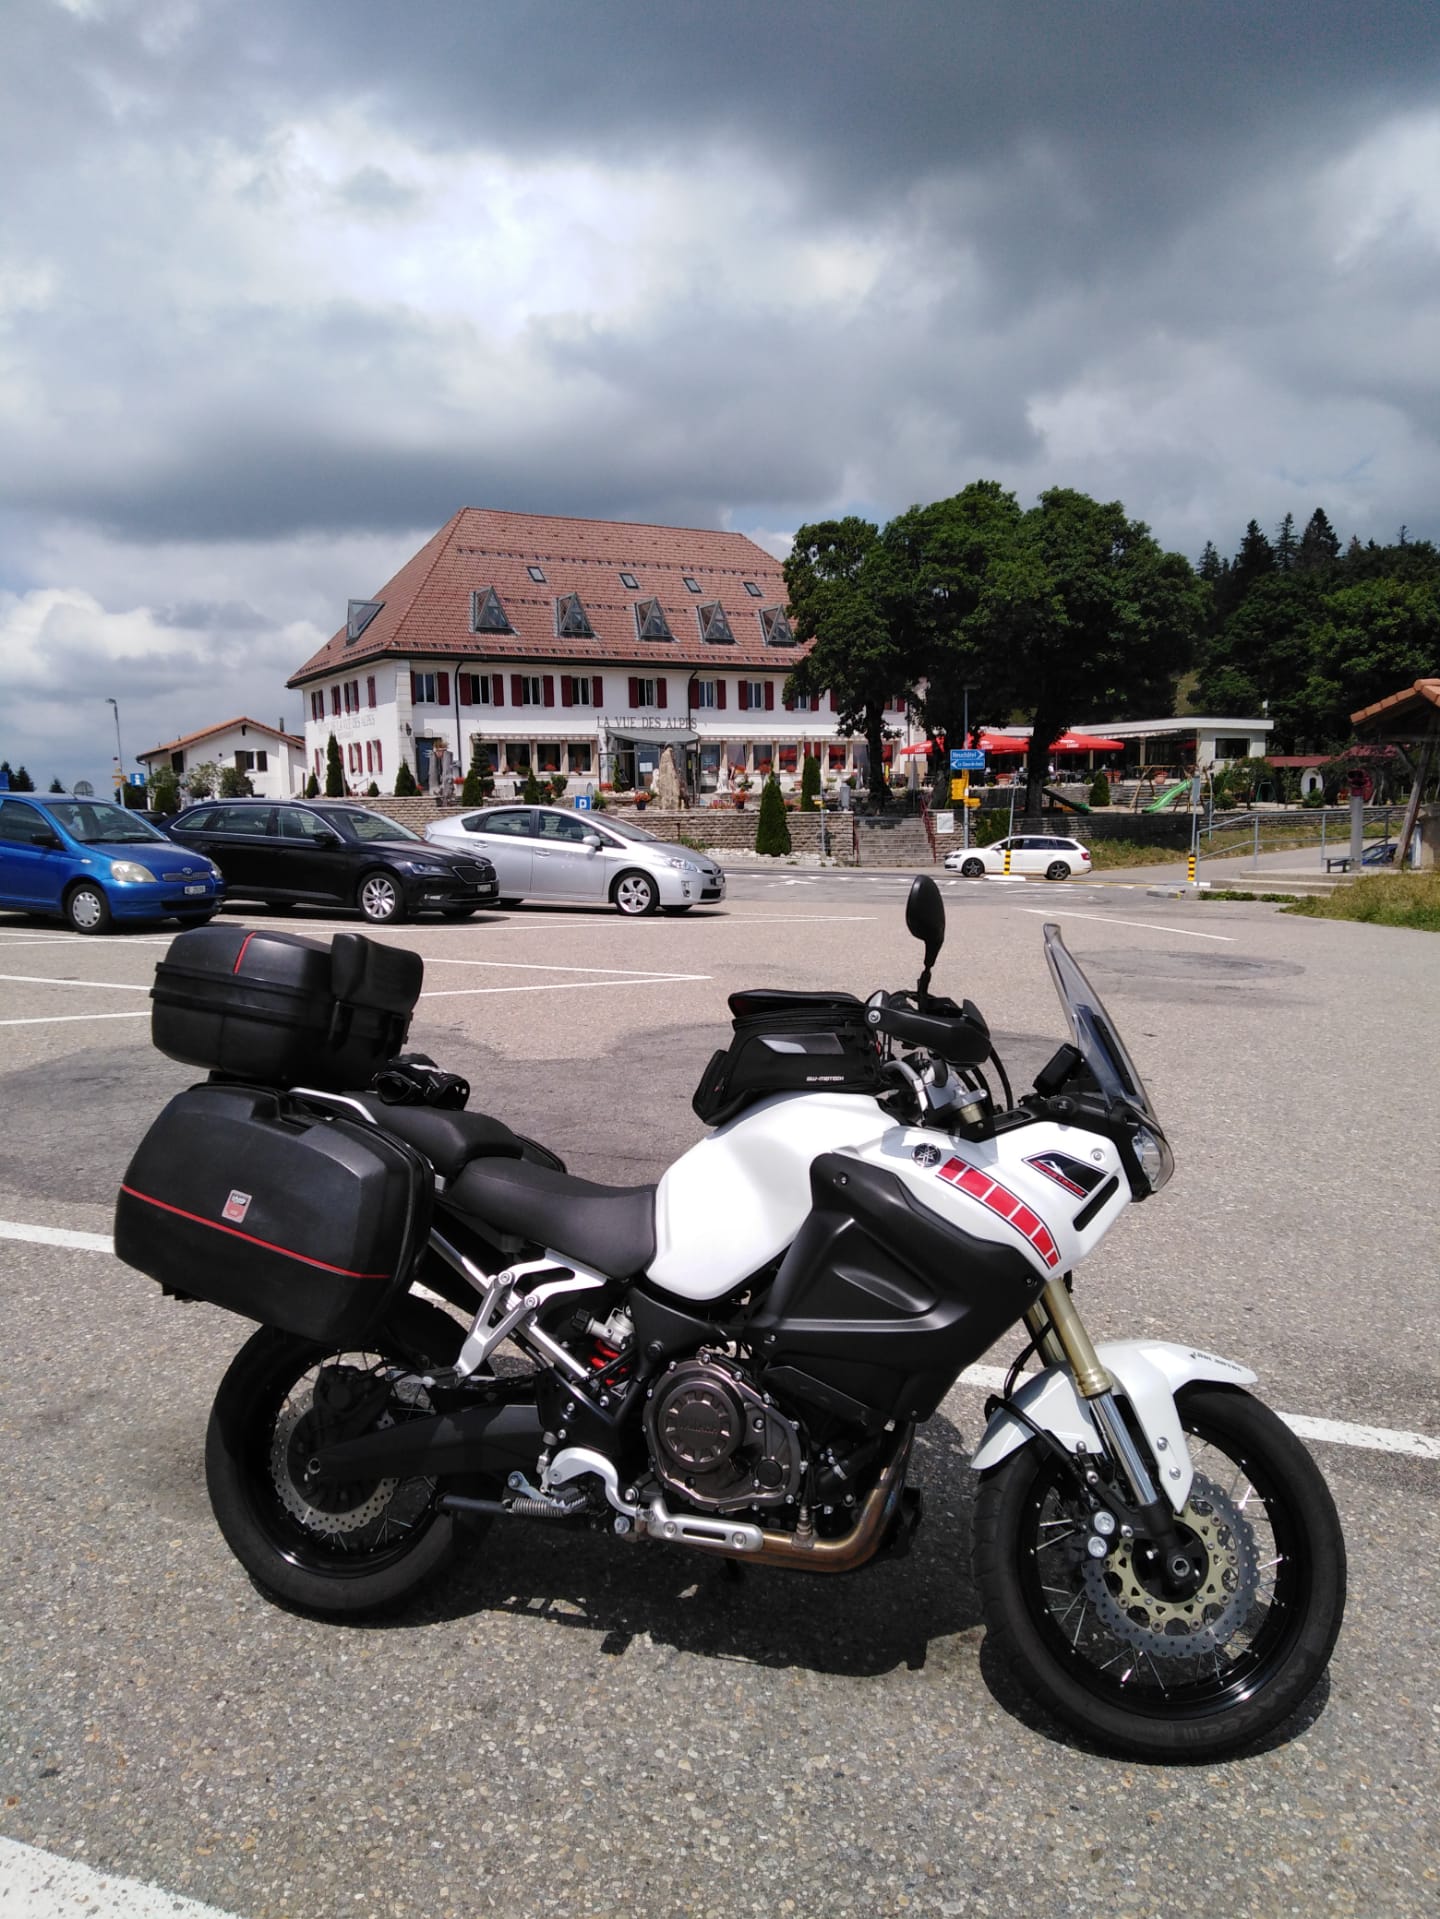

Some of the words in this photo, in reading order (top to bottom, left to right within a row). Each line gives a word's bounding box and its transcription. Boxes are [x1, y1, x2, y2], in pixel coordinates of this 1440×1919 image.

[597, 715, 610, 728] LA
[615, 716, 637, 728] VUE
[642, 716, 661, 729] DES
[579, 799, 587, 809] P
